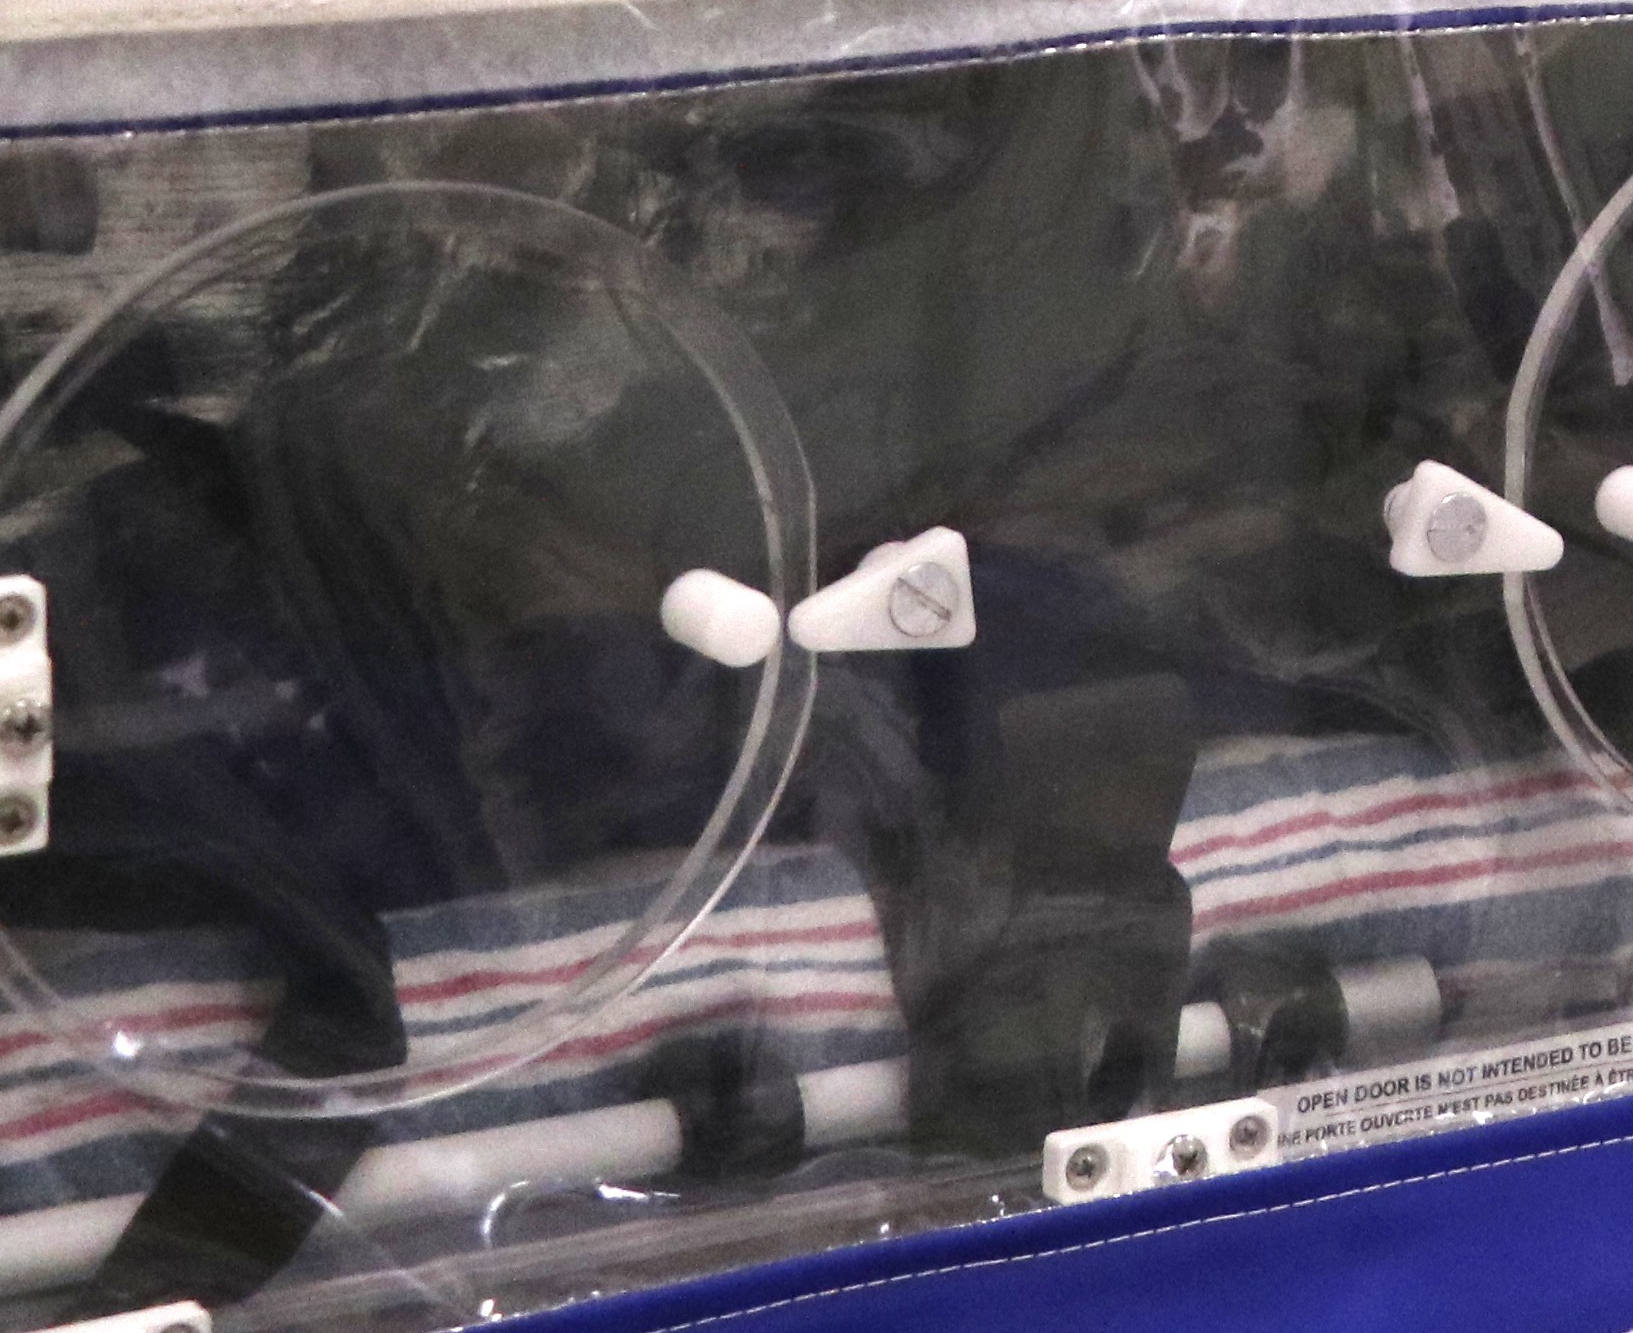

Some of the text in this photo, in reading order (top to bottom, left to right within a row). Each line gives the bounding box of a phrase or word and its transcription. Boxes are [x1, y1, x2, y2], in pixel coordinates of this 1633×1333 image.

[1297, 1088, 1349, 1114] OPEN
[1354, 1076, 1410, 1103] DOOR
[1415, 1074, 1432, 1091] IS
[1438, 1066, 1478, 1087] NOT
[1482, 1047, 1574, 1080] INTENDED
[1579, 1042, 1602, 1061] TO
[1607, 1035, 1633, 1057] BE
[1305, 1120, 1357, 1143] PORTE
[1360, 1105, 1433, 1132] OUVERTE
[1484, 1090, 1514, 1109] PAS
[1518, 1073, 1590, 1103] DESTINÉE
